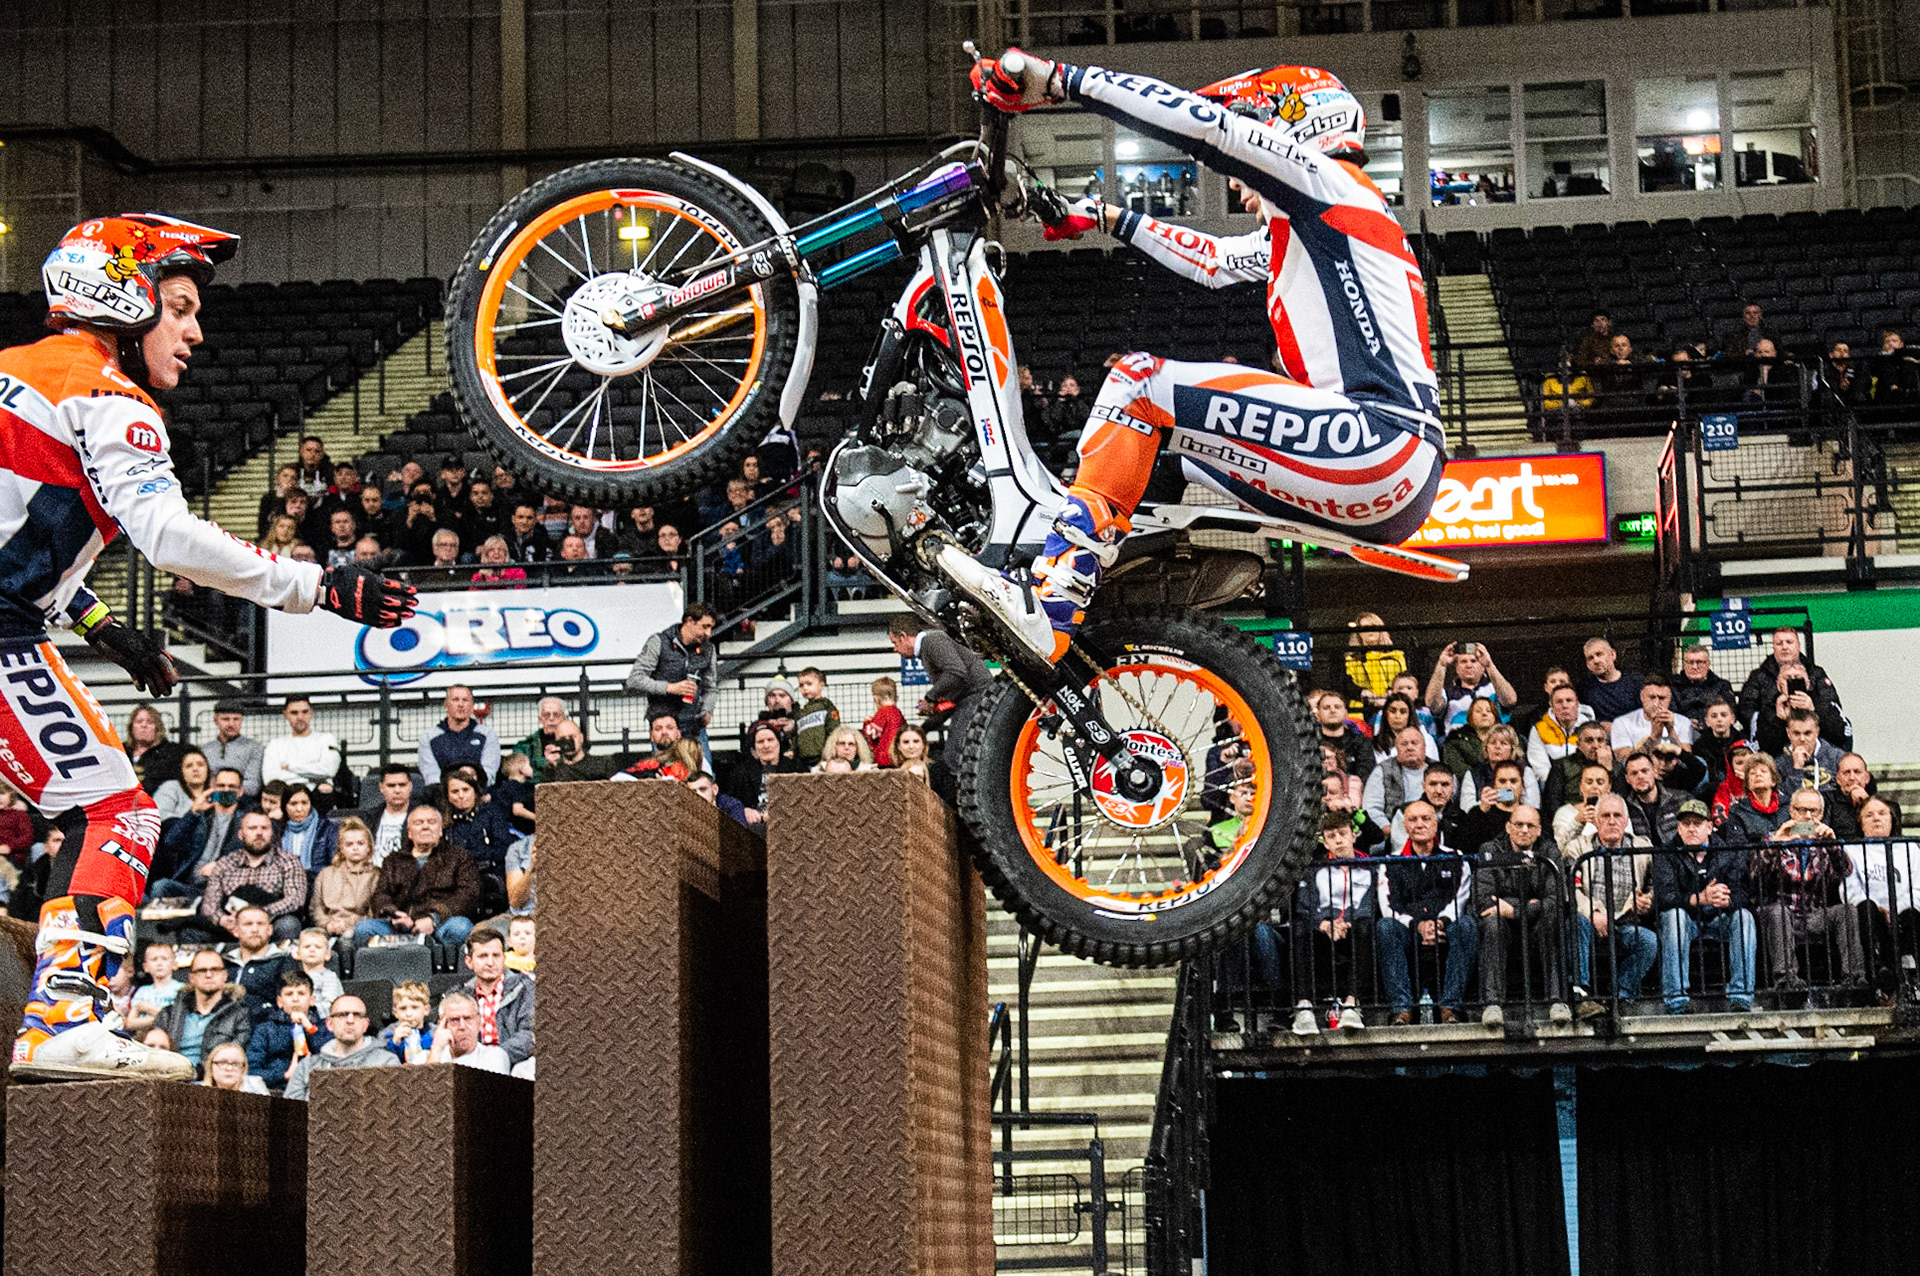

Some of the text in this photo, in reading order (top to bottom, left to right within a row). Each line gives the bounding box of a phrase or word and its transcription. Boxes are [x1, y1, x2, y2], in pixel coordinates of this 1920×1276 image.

[1294, 111, 1348, 145] ebo
[678, 201, 739, 252] REPSOL
[1145, 218, 1218, 259] HON
[1226, 250, 1271, 271] heb
[58, 270, 144, 320] hebo
[672, 271, 728, 307] SHOWA
[1334, 259, 1382, 357] HONDA
[950, 293, 987, 387] REPSOL
[1090, 405, 1154, 437] ebo
[1204, 395, 1381, 454] REPSOL
[1706, 422, 1735, 437] 210
[1180, 435, 1267, 475] hebo
[1228, 470, 1415, 521] Montesa
[1430, 462, 1545, 524] eart
[355, 607, 600, 686] OREO
[1715, 619, 1746, 634] 110
[904, 657, 925, 670] 11
[1277, 640, 1308, 655] 110
[0, 648, 101, 780] EPSOL
[1059, 685, 1085, 712] NGK
[0, 736, 35, 786] tesa
